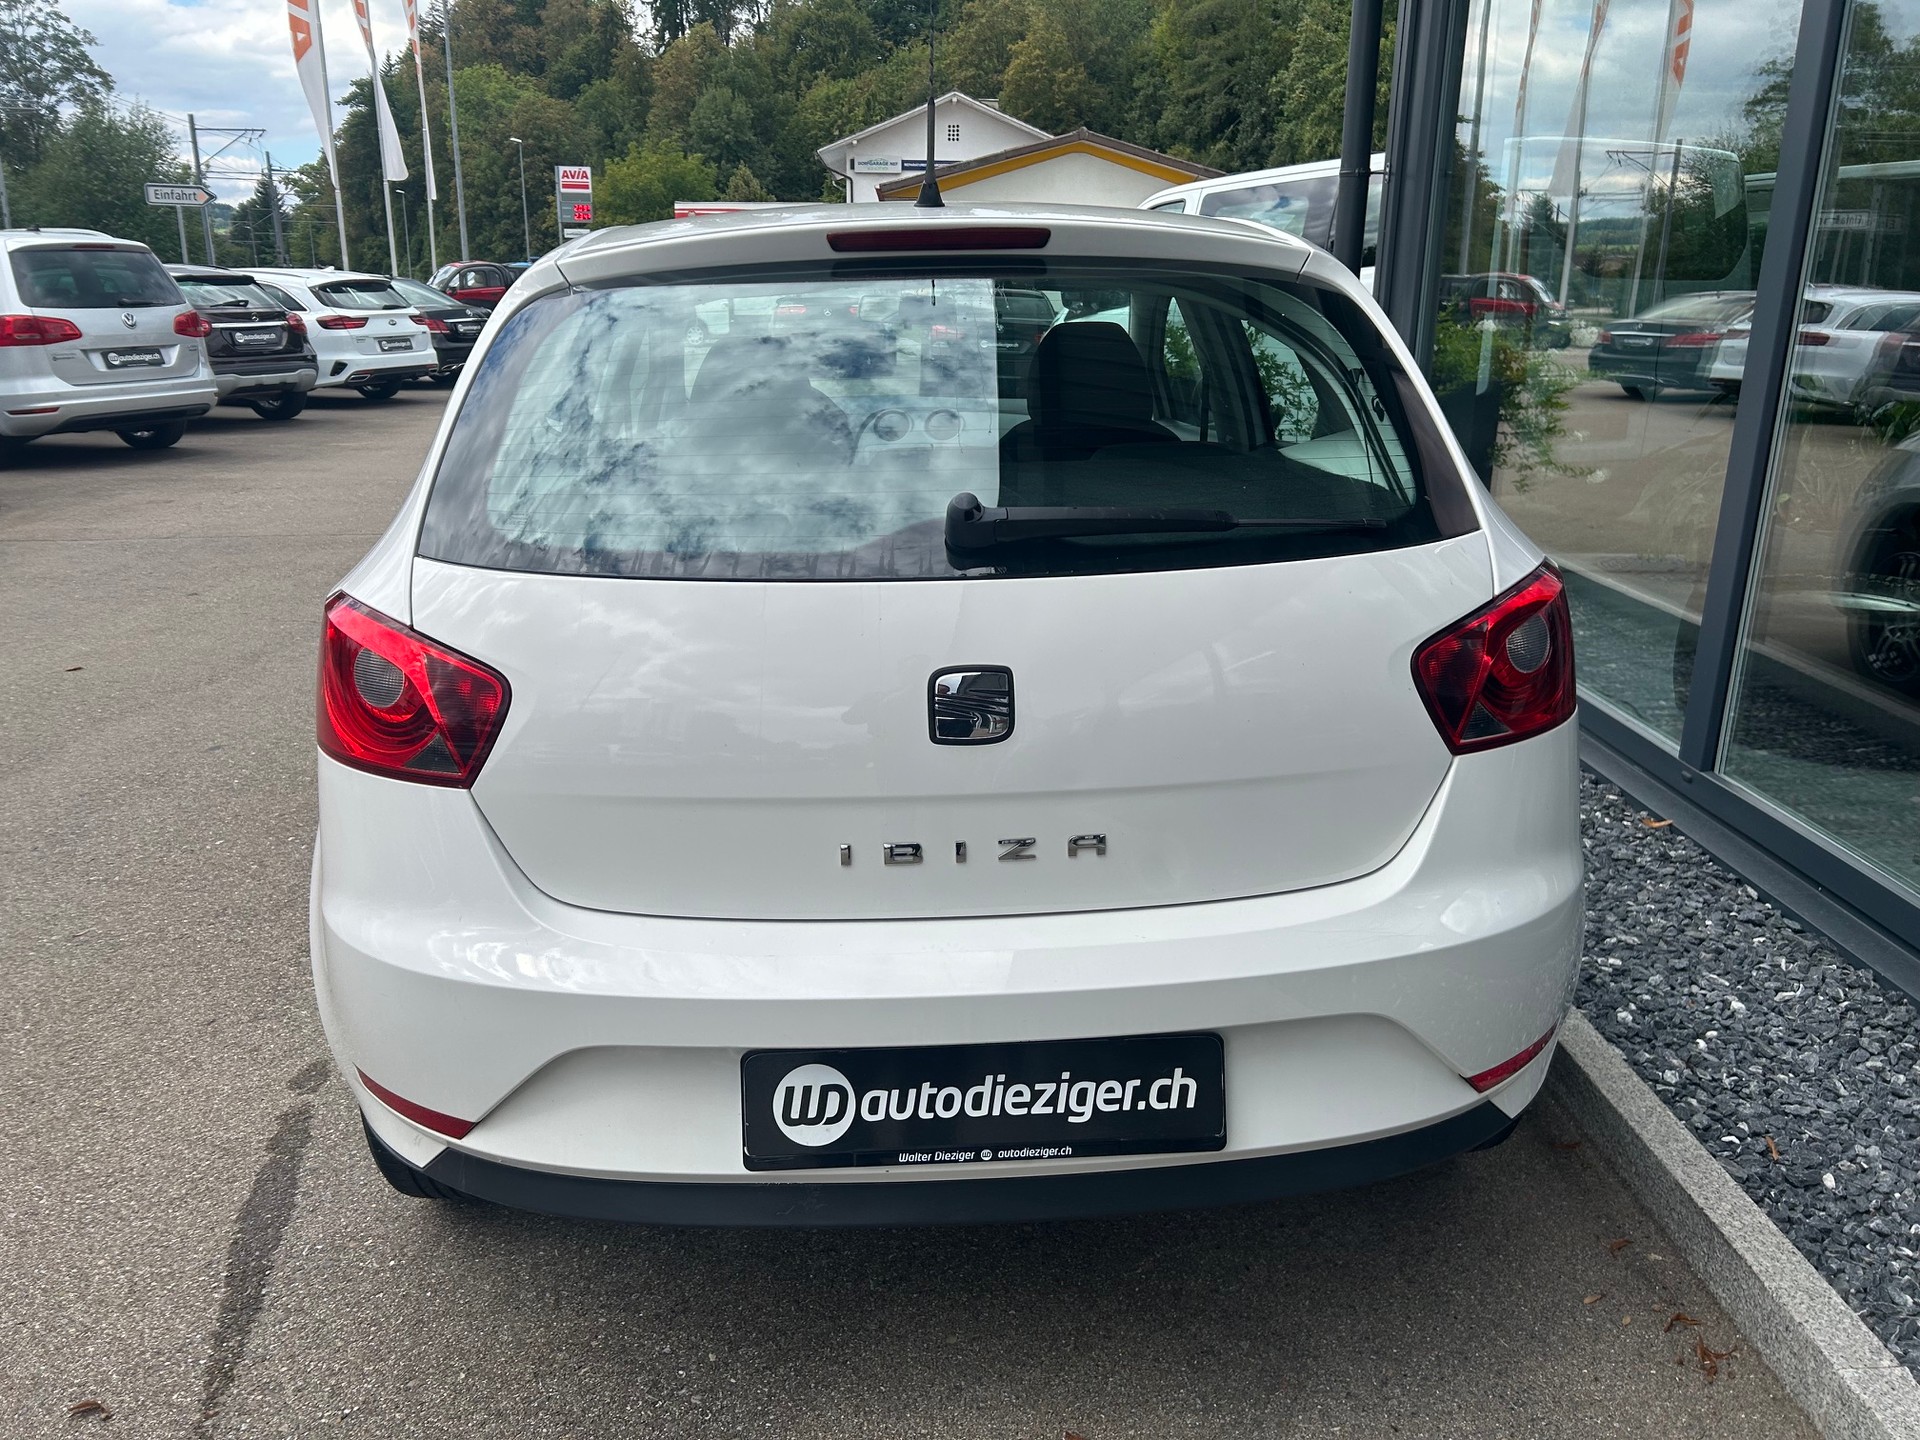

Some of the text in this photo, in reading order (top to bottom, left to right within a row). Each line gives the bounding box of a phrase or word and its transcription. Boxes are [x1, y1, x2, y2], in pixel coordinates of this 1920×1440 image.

[561, 168, 589, 180] AVIA
[153, 189, 198, 202] Einfahrt
[839, 833, 1107, 867] IBIZA
[859, 1066, 1199, 1124] autodieziger.ch
[898, 1153, 932, 1163] Walter
[934, 1151, 976, 1163] Dieziger
[997, 1145, 1072, 1159] autodieziger.ch
